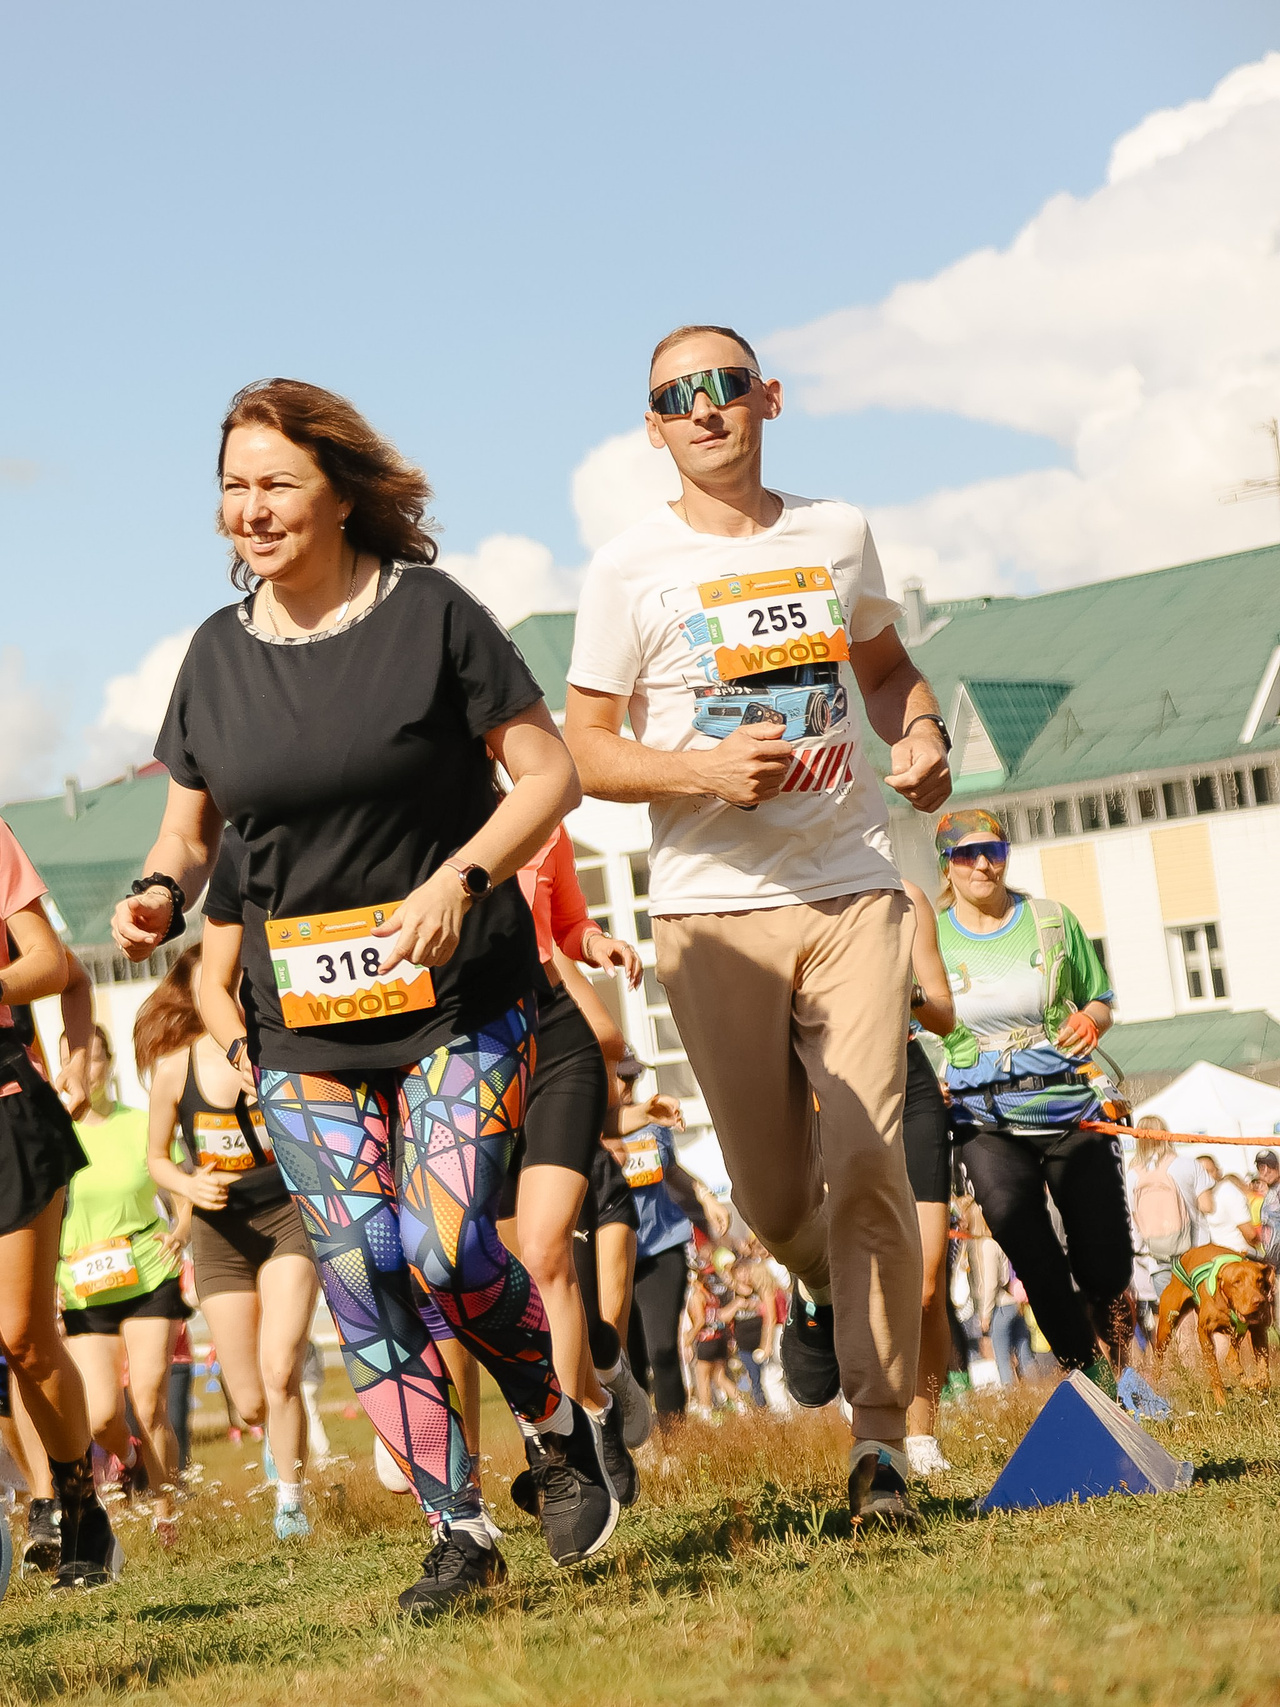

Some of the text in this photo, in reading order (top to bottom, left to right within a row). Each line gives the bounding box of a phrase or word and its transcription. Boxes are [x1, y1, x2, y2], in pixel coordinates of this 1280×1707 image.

[748, 603, 807, 636] 255
[741, 642, 830, 671] WOOD
[317, 948, 381, 984] 318
[308, 990, 409, 1022] WOOD
[87, 1256, 115, 1275] 282
